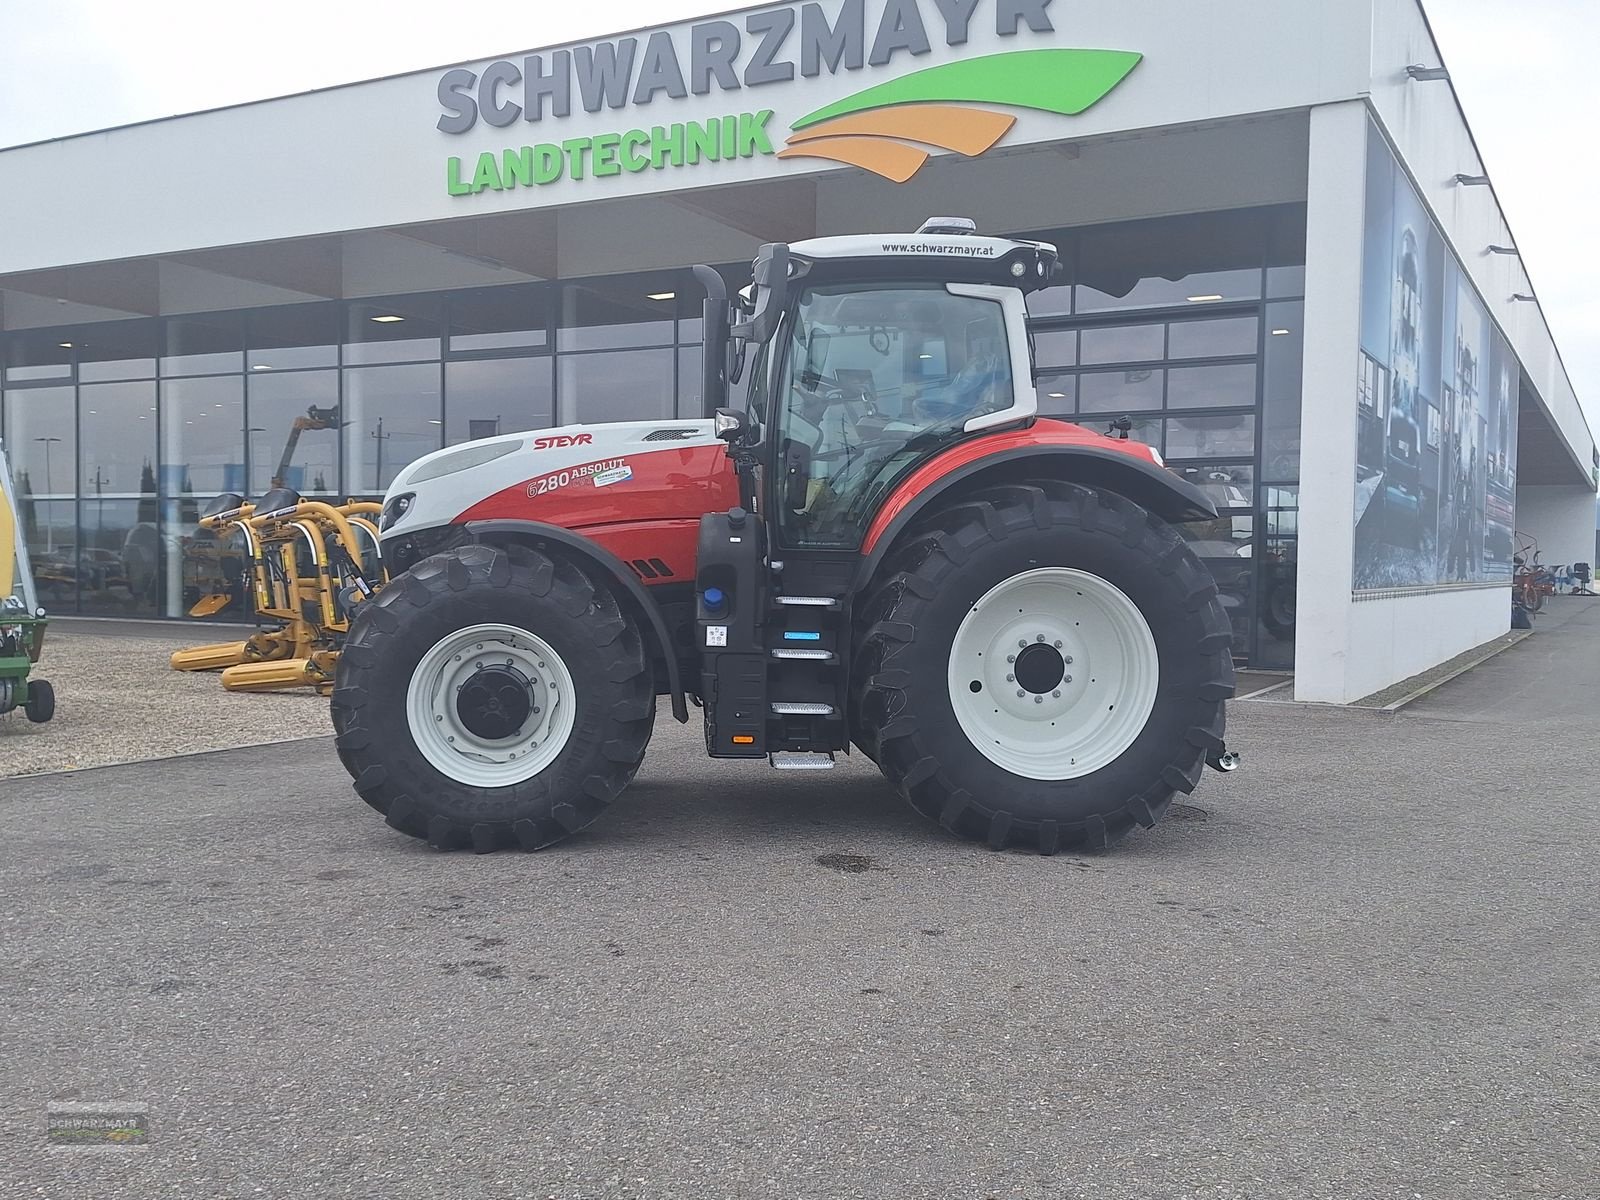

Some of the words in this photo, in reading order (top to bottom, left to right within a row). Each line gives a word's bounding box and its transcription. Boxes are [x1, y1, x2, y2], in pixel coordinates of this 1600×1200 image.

[447, 109, 775, 197] LANDTECHNIK
[881, 243, 994, 256] www.schwarzmayr.at
[533, 433, 593, 450] STEYR
[527, 472, 570, 498] 6280
[571, 459, 625, 479] ABSOLUT
